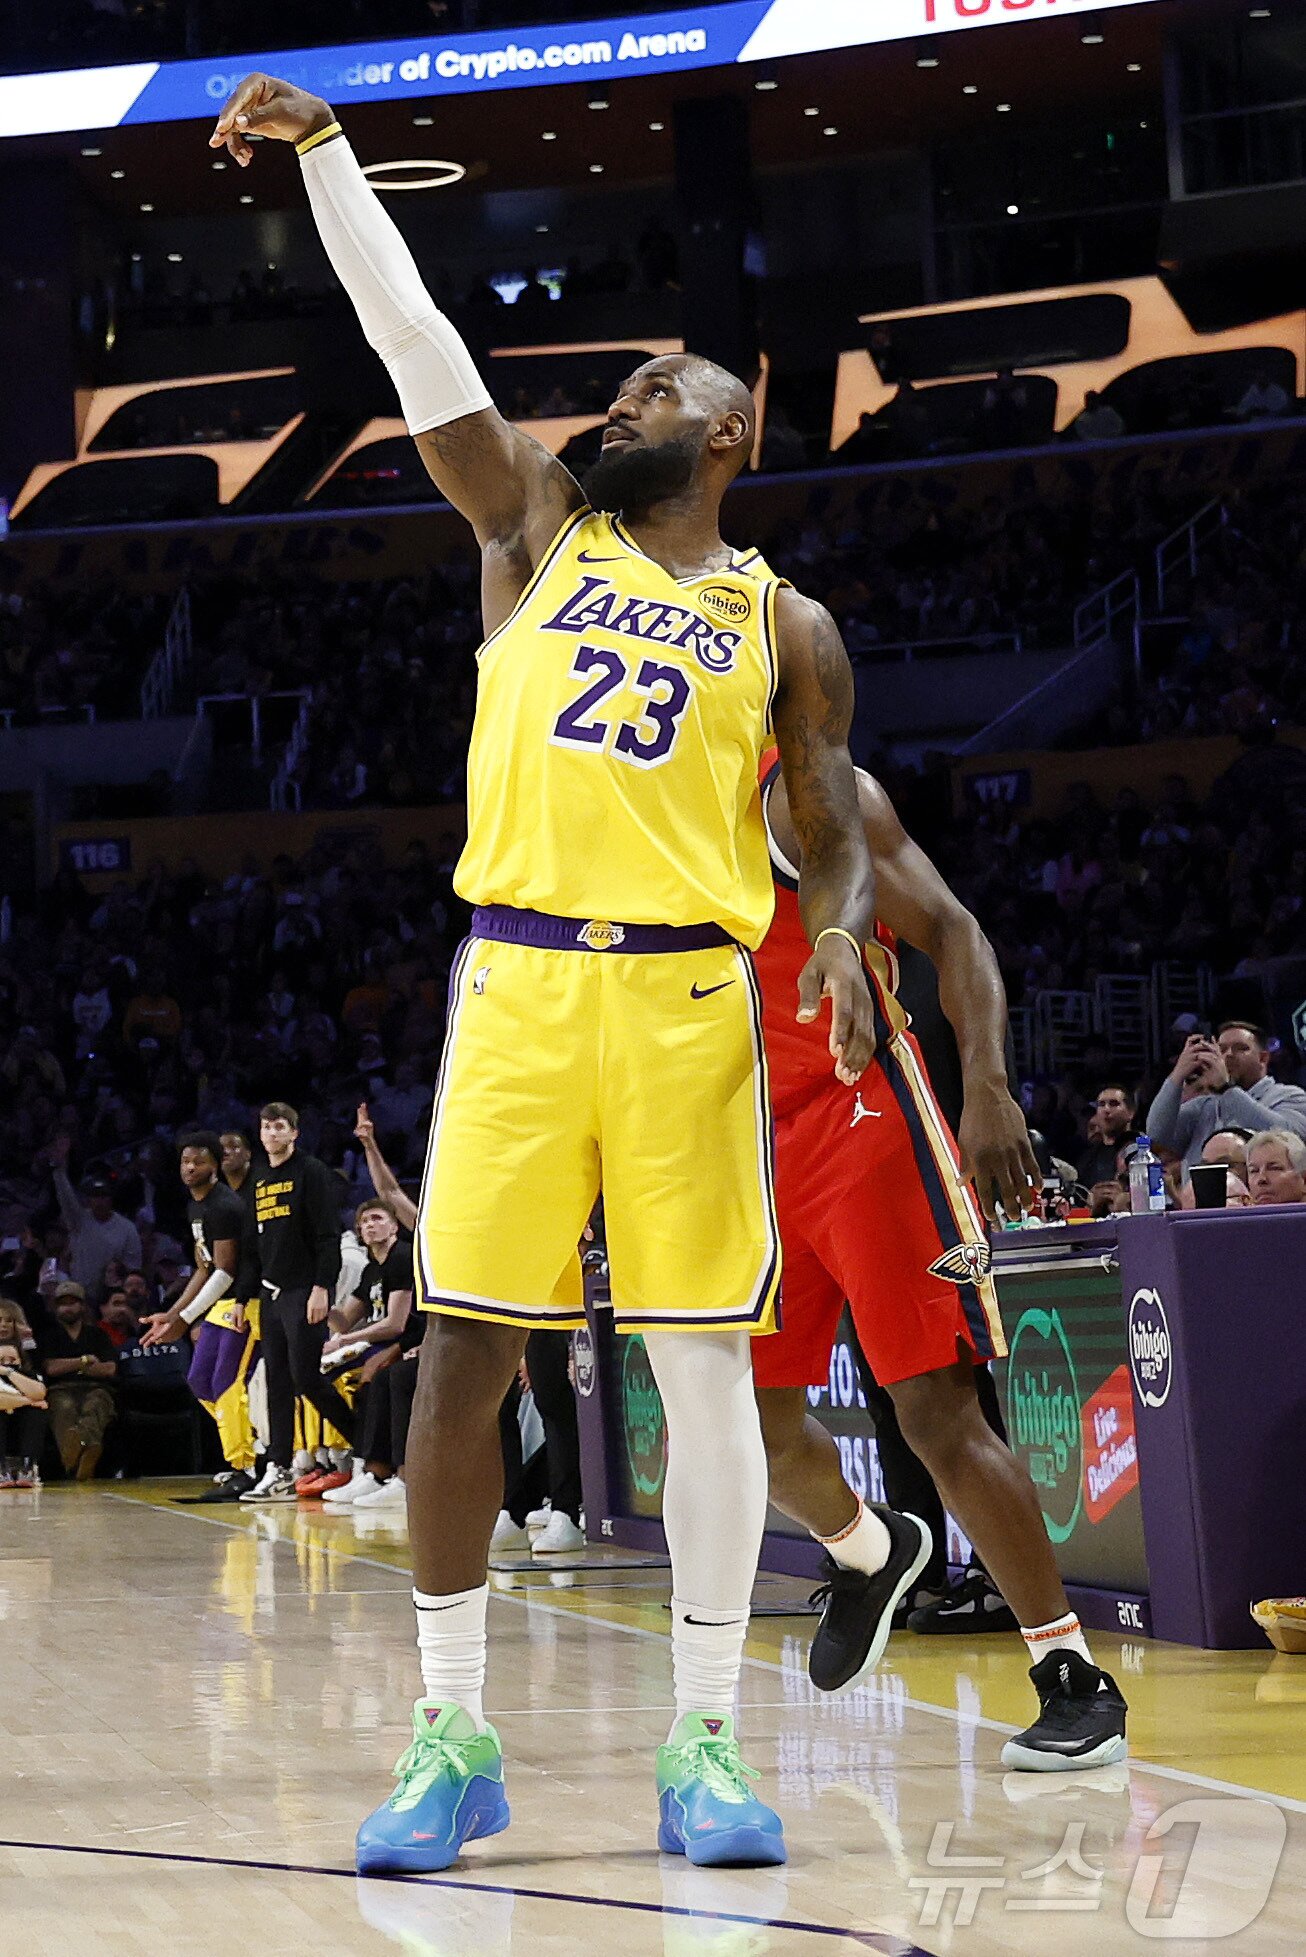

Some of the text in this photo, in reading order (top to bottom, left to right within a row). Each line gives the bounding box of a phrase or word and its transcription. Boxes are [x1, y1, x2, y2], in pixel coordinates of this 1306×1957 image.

[399, 52, 430, 82] of
[435, 43, 612, 80] Crypto.com
[616, 28, 707, 61] Arena
[538, 574, 743, 674] LAKERS
[703, 593, 747, 616] bibigo
[551, 644, 694, 767] 23
[1132, 1320, 1168, 1372] bibigo
[1014, 1371, 1078, 1474] bibigo
